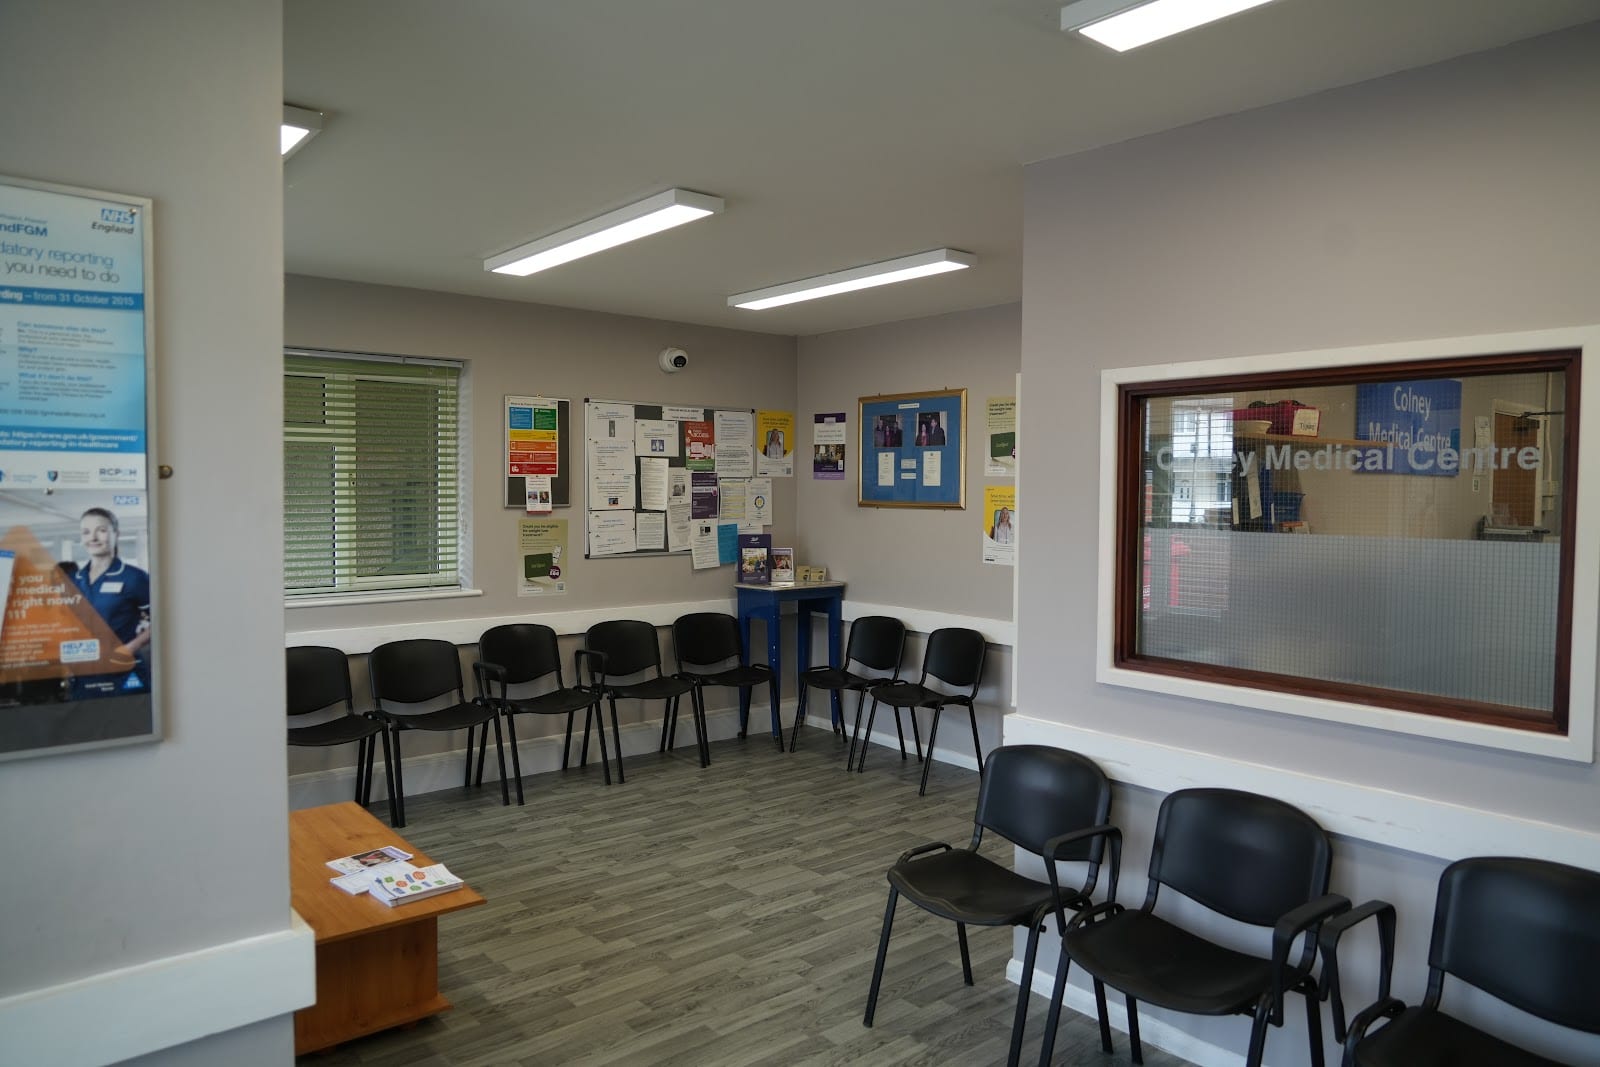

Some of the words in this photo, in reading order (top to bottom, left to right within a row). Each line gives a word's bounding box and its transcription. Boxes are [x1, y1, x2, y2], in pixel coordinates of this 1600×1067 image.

[102, 208, 134, 224] NHS
[91, 222, 134, 235] England
[48, 249, 114, 269] reporting
[5, 261, 34, 275] you
[38, 264, 77, 279] need
[81, 268, 96, 281] to
[99, 271, 120, 284] do
[33, 291, 57, 301] from
[60, 293, 70, 302] 31
[73, 294, 109, 304] October
[111, 296, 134, 306] 2015
[1393, 386, 1432, 421] Colney
[1369, 421, 1414, 450] Medical
[1417, 428, 1451, 452] Centre
[1265, 443, 1394, 471] Medical
[1407, 442, 1541, 471] Centre
[113, 495, 140, 505] NHS
[19, 575, 44, 584] you
[16, 583, 65, 594] medical
[13, 596, 43, 609] right
[46, 594, 83, 606] now?
